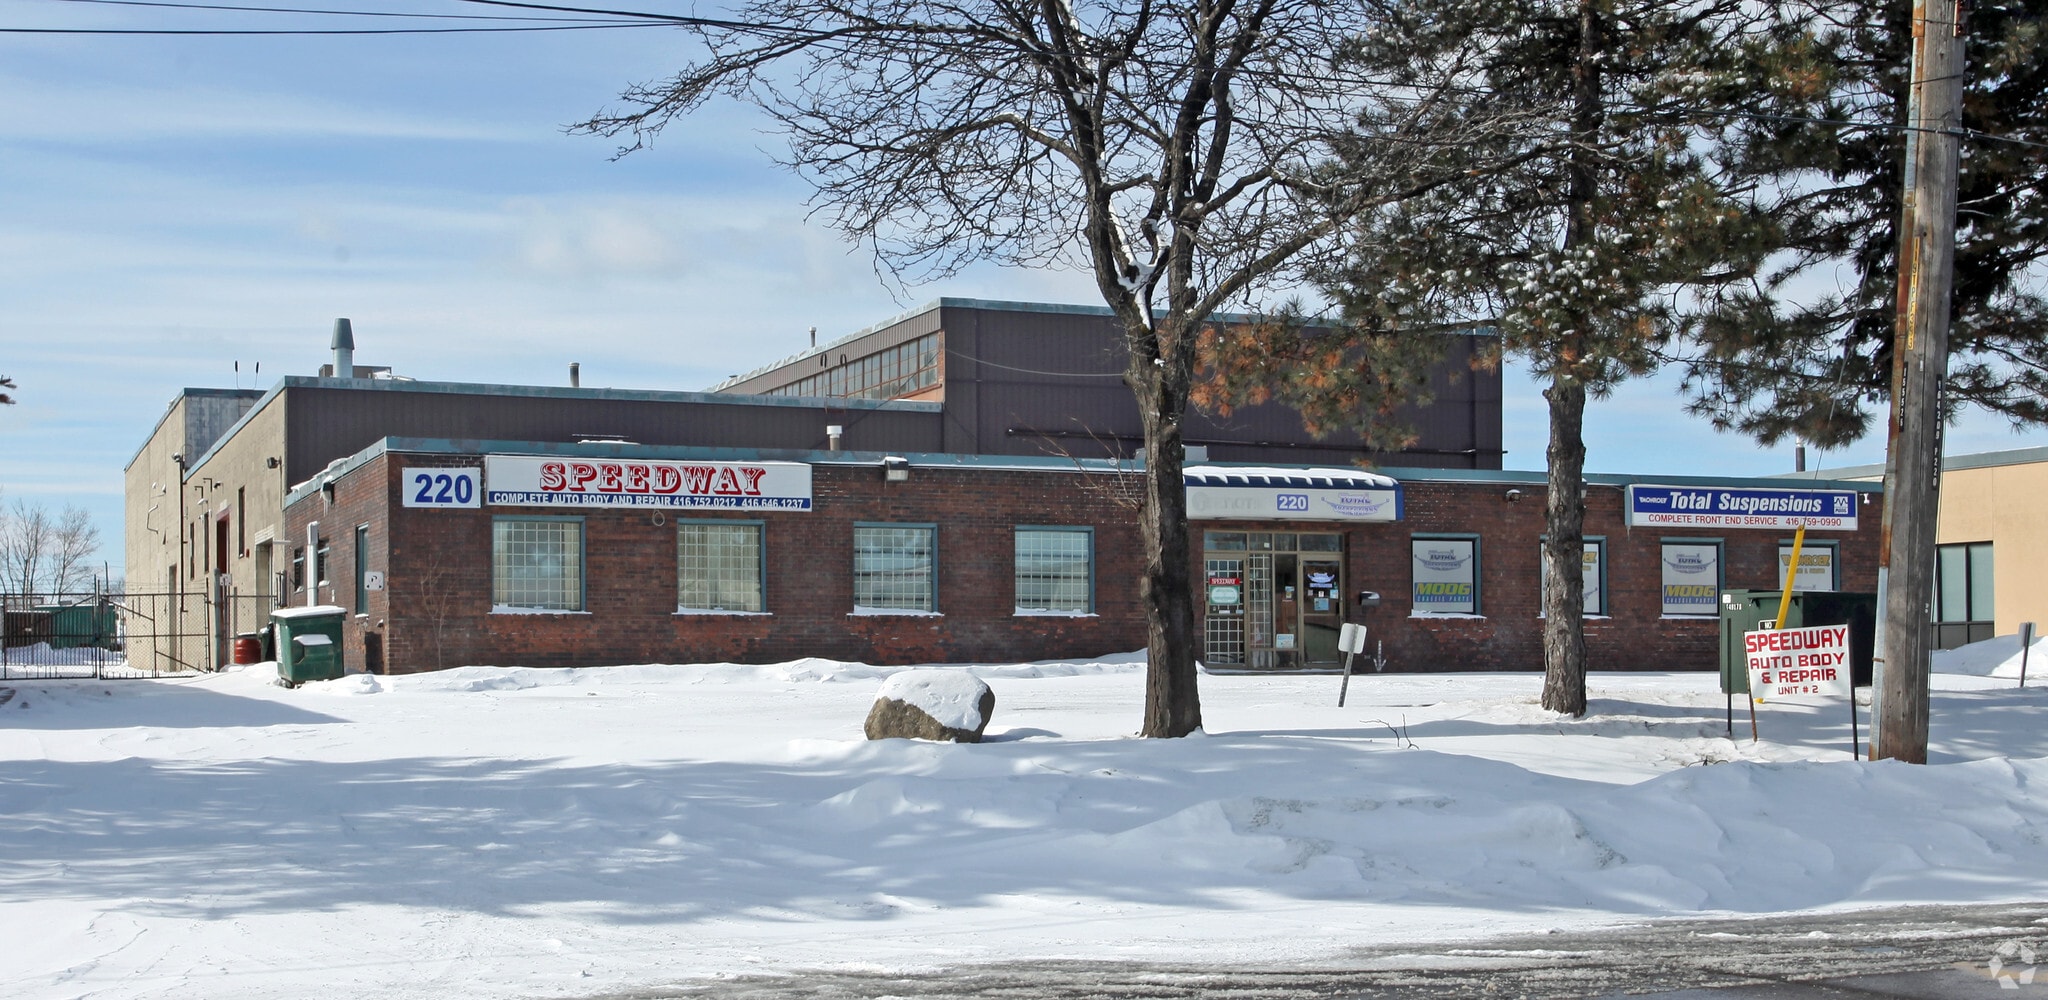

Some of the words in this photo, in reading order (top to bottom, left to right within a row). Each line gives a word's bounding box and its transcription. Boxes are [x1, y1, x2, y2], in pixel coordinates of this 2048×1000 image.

[539, 462, 766, 495] SPEEDWAY
[415, 474, 472, 503] 220
[494, 492, 549, 504] COMPLETE
[552, 494, 579, 504] AUTO
[584, 495, 610, 505] BODY
[612, 495, 633, 505] AND
[635, 495, 671, 506] REPAIR
[673, 496, 736, 507] 416.752.0212
[741, 498, 803, 508] 416.646.1237
[1279, 496, 1306, 509] 220
[1670, 492, 1712, 509] Total
[1719, 493, 1822, 514] Suspensions
[1648, 514, 1692, 523] COMPLETE
[1695, 515, 1722, 524] FRONT
[1725, 516, 1742, 525] END
[1744, 516, 1778, 525] SERVICE
[1785, 517, 1799, 526] 416
[1802, 517, 1842, 527] 759-0990
[1416, 582, 1472, 595] MOOG
[1665, 585, 1716, 597] MOOG
[1746, 629, 1846, 652] SPEEDWAY
[1750, 655, 1792, 670] AUTO
[1799, 652, 1844, 667] BODY
[1761, 672, 1773, 684] &
[1779, 669, 1836, 683] REPAIR
[1778, 685, 1799, 695] UNIT
[1802, 686, 1809, 694] #
[1812, 685, 1819, 694] 2
